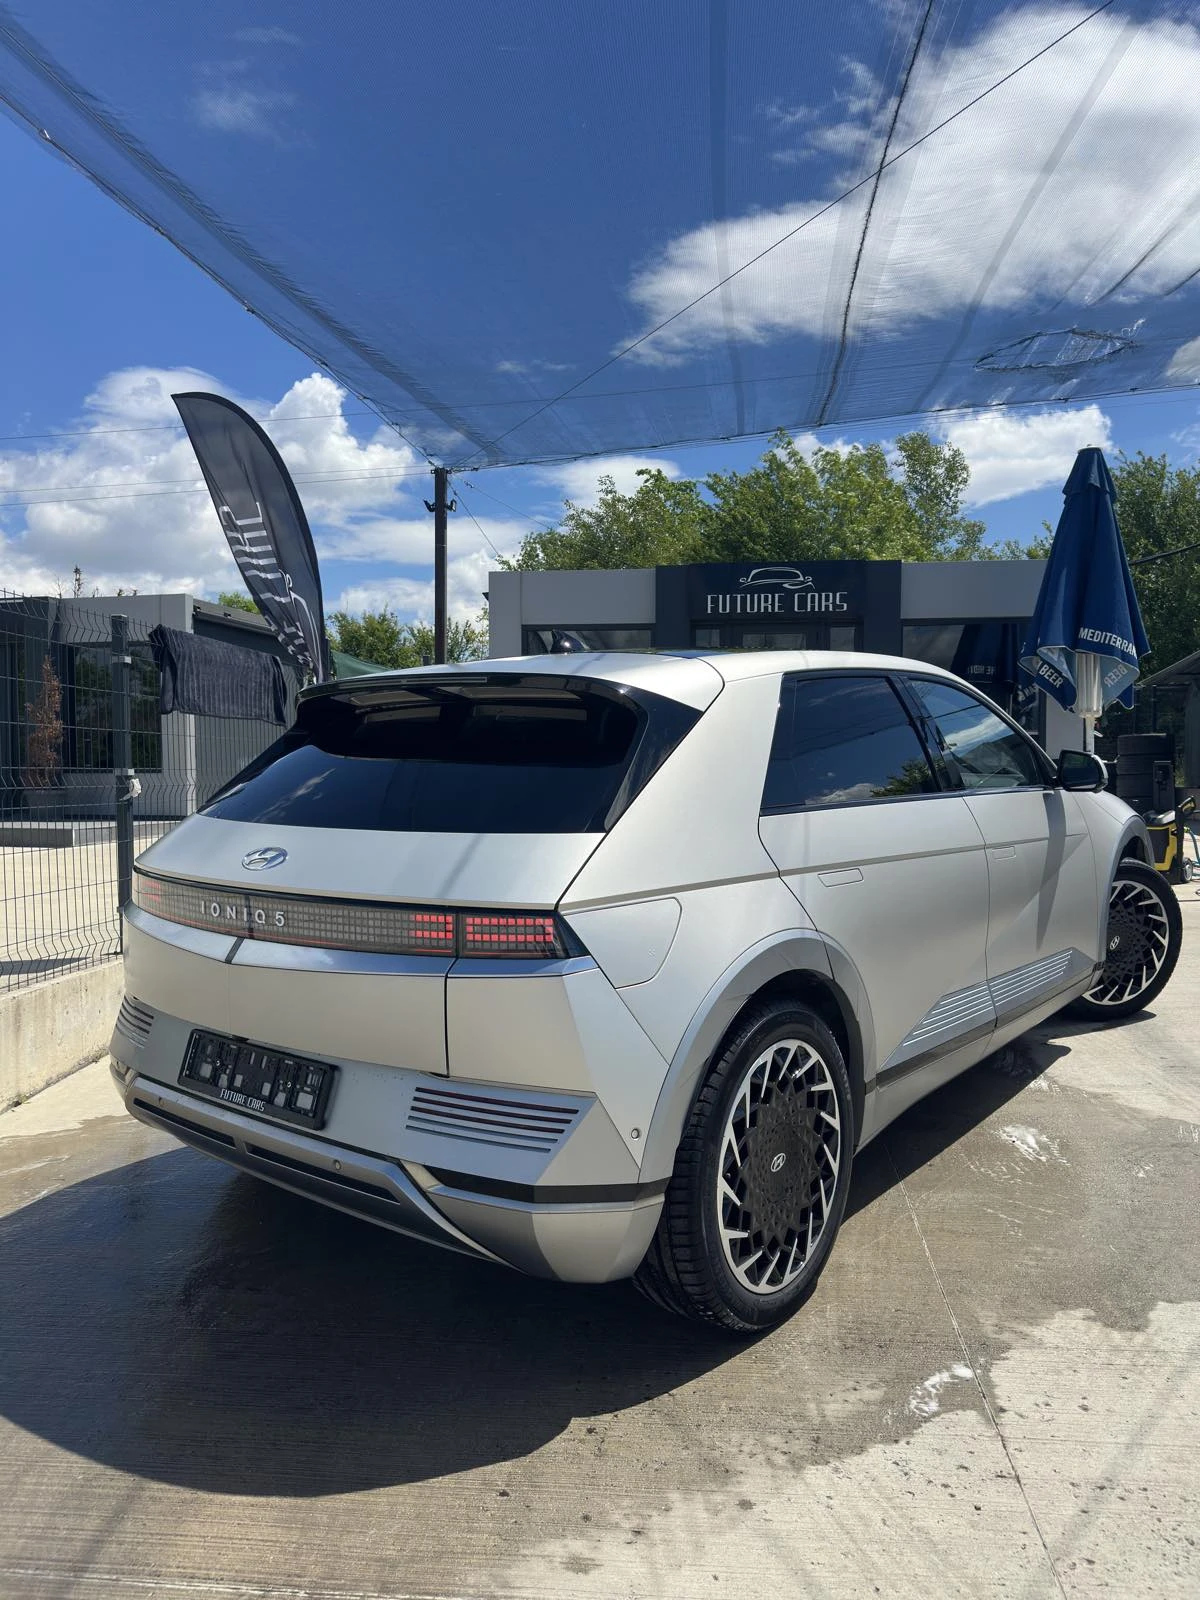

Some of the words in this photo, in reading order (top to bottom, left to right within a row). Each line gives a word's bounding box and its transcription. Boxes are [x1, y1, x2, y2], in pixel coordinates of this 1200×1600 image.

[707, 593, 785, 614] FUTURE
[794, 592, 848, 612] CARS
[1039, 664, 1064, 689] BEER
[201, 901, 266, 924] IONIQ
[275, 911, 285, 927] 5
[219, 1088, 249, 1106] FUTURE
[248, 1096, 267, 1112] CARS
